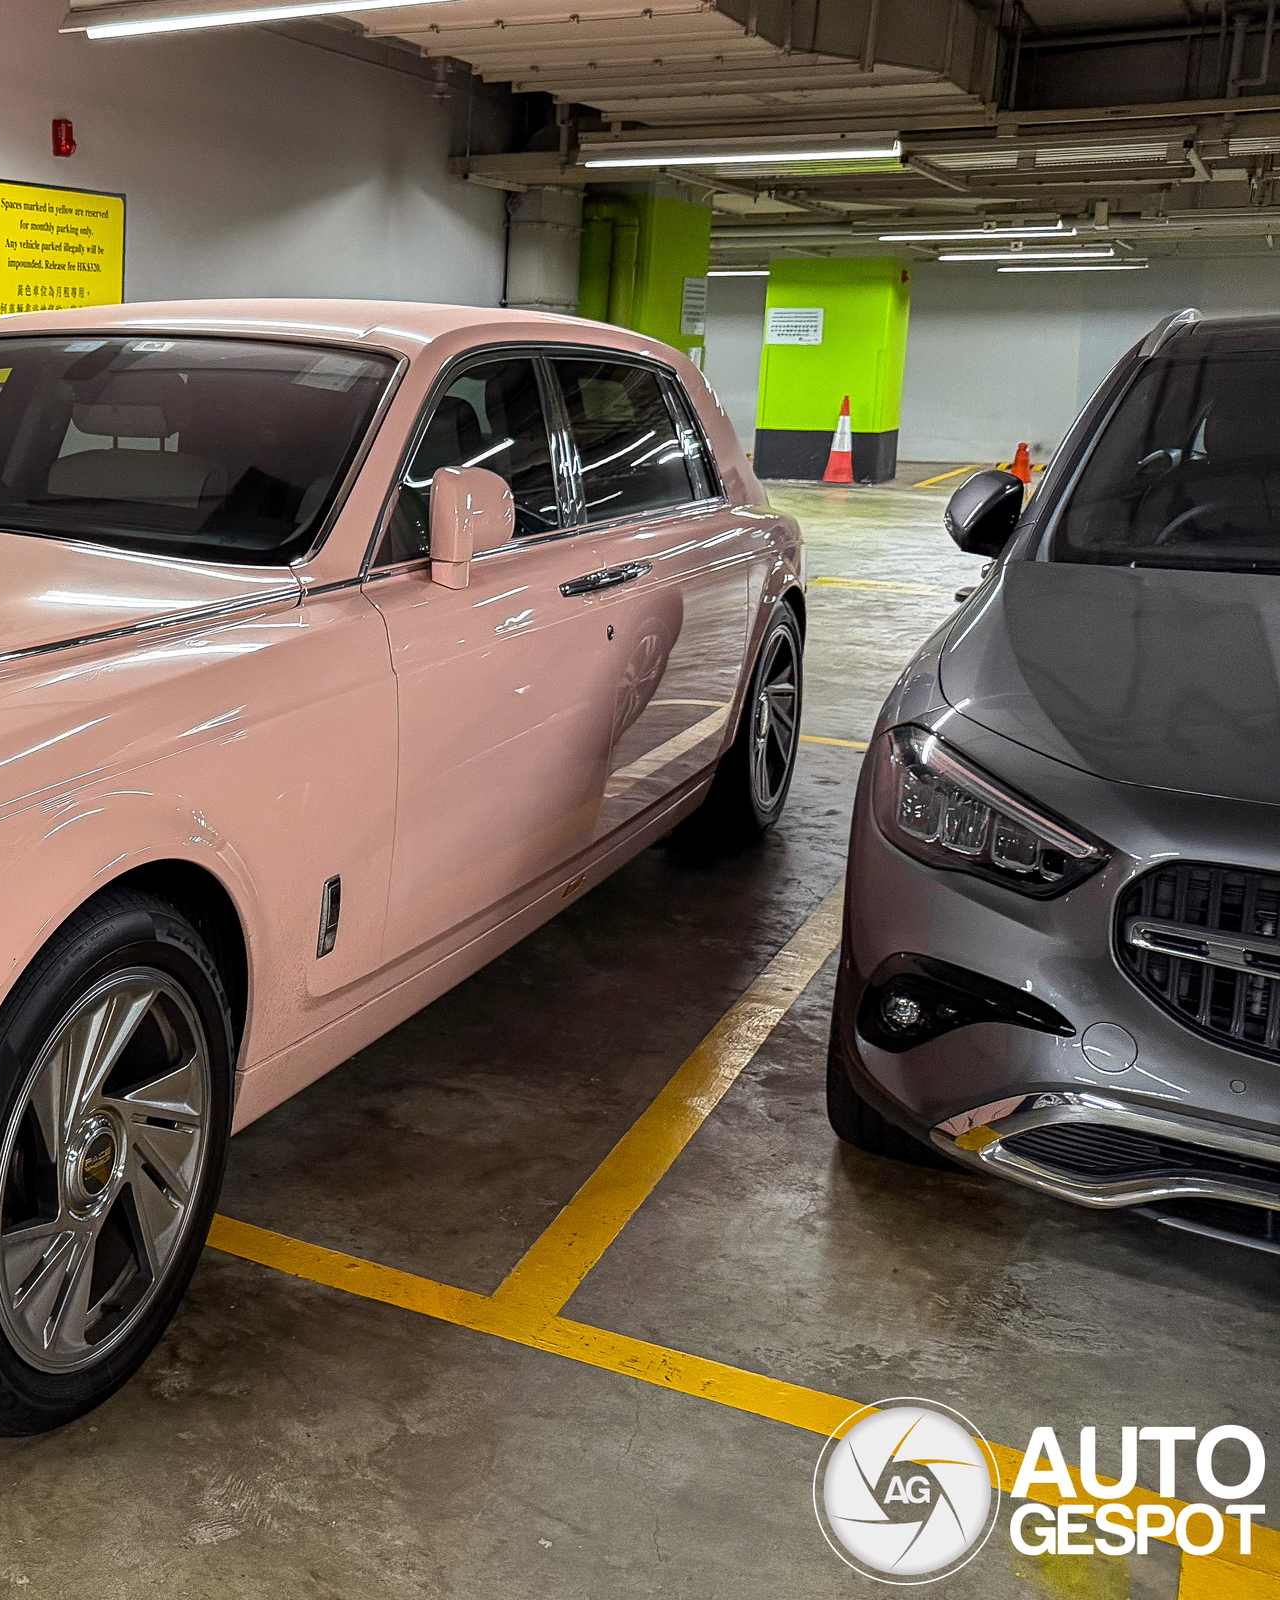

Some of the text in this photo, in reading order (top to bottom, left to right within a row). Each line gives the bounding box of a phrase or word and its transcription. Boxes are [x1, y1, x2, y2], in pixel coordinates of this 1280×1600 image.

[1, 198, 109, 218] Spaces marked in yellow are reserved
[20, 219, 29, 230] for
[30, 222, 54, 234] monthly
[56, 224, 79, 237] parking
[5, 238, 105, 255] Any vehicle parked illegally will be
[8, 257, 44, 270] impounded.
[45, 260, 66, 271] Release
[67, 261, 76, 271] fee
